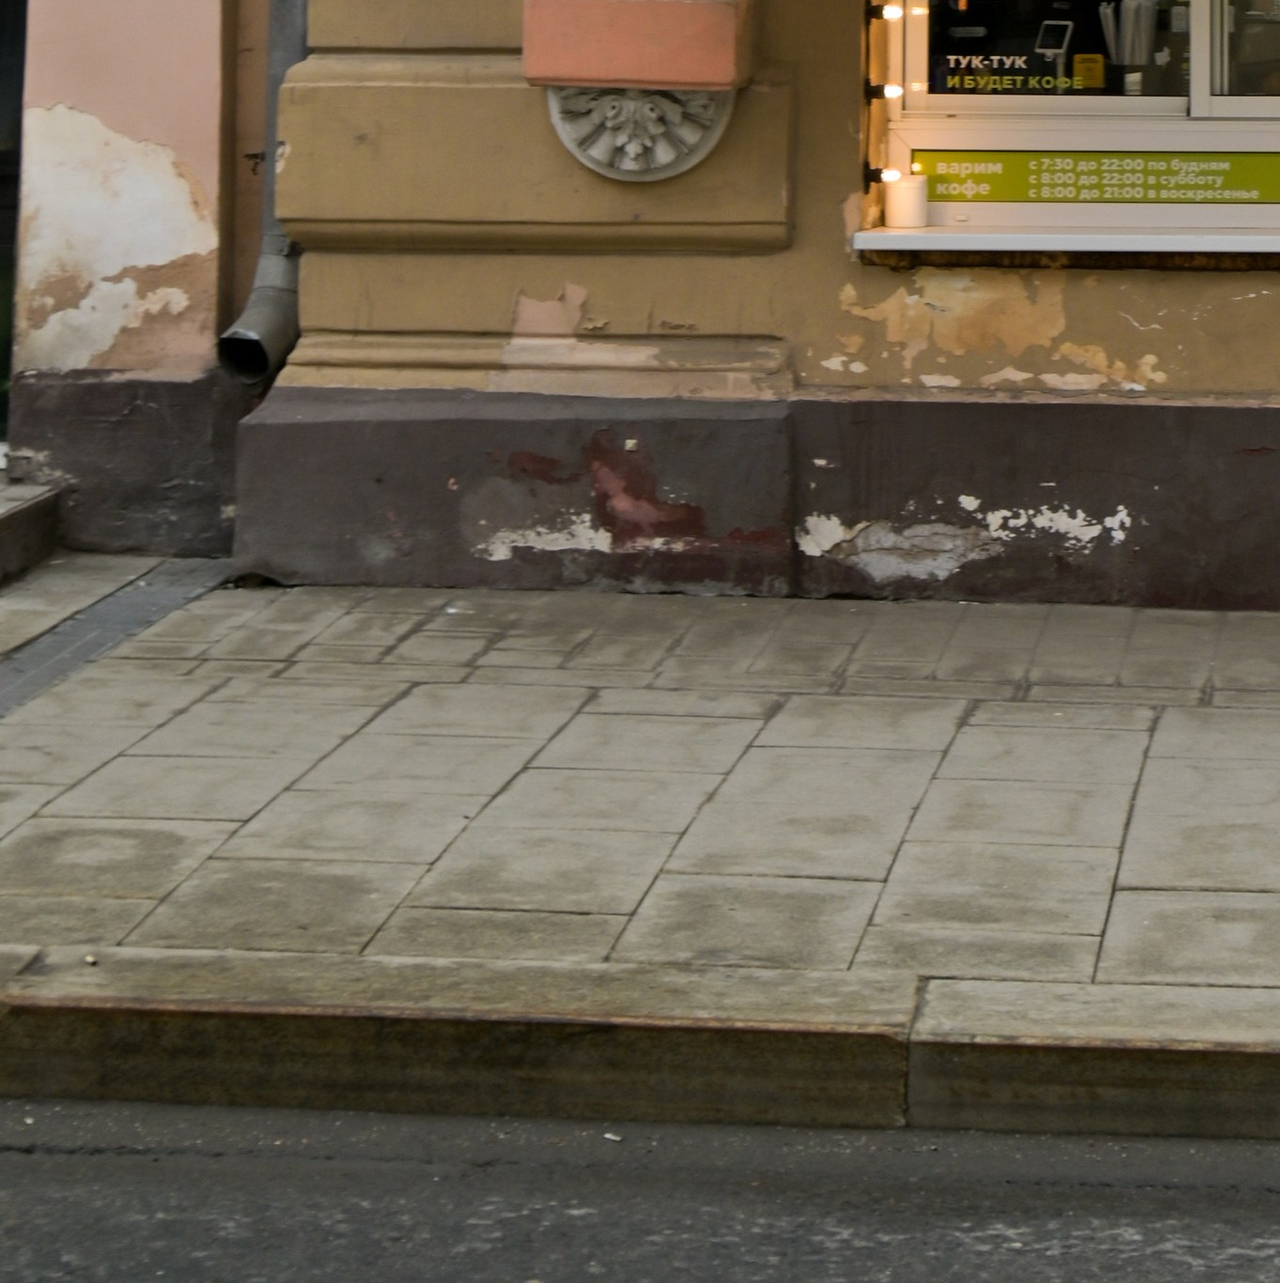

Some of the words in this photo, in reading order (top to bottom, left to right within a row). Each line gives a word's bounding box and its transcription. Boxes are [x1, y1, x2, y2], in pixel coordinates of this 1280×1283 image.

[946, 55, 1027, 68] ТУК-ТУК
[947, 76, 960, 88] И
[964, 76, 1024, 91] БУДЕТ
[1029, 75, 1084, 89] КОФЕ
[936, 162, 1002, 176] варим
[1029, 161, 1037, 170] с
[1041, 159, 1073, 170] 7:30
[1076, 161, 1097, 173] до
[1101, 159, 1144, 170] 22:00
[1147, 162, 1167, 171] по
[1170, 159, 1230, 173] будням
[1029, 175, 1037, 184] с
[1041, 173, 1075, 184] 8:00
[1078, 175, 1098, 186] до
[1101, 173, 1144, 184] 22:00
[1147, 176, 1156, 184] в
[1160, 173, 1224, 187] субботу
[936, 180, 990, 198] кофе
[1029, 189, 1037, 198] с
[1041, 187, 1075, 198] 8:00
[1079, 190, 1099, 201] до
[1103, 187, 1144, 198] 21:00
[1147, 190, 1156, 198] в
[1160, 190, 1259, 201] воскресенье
